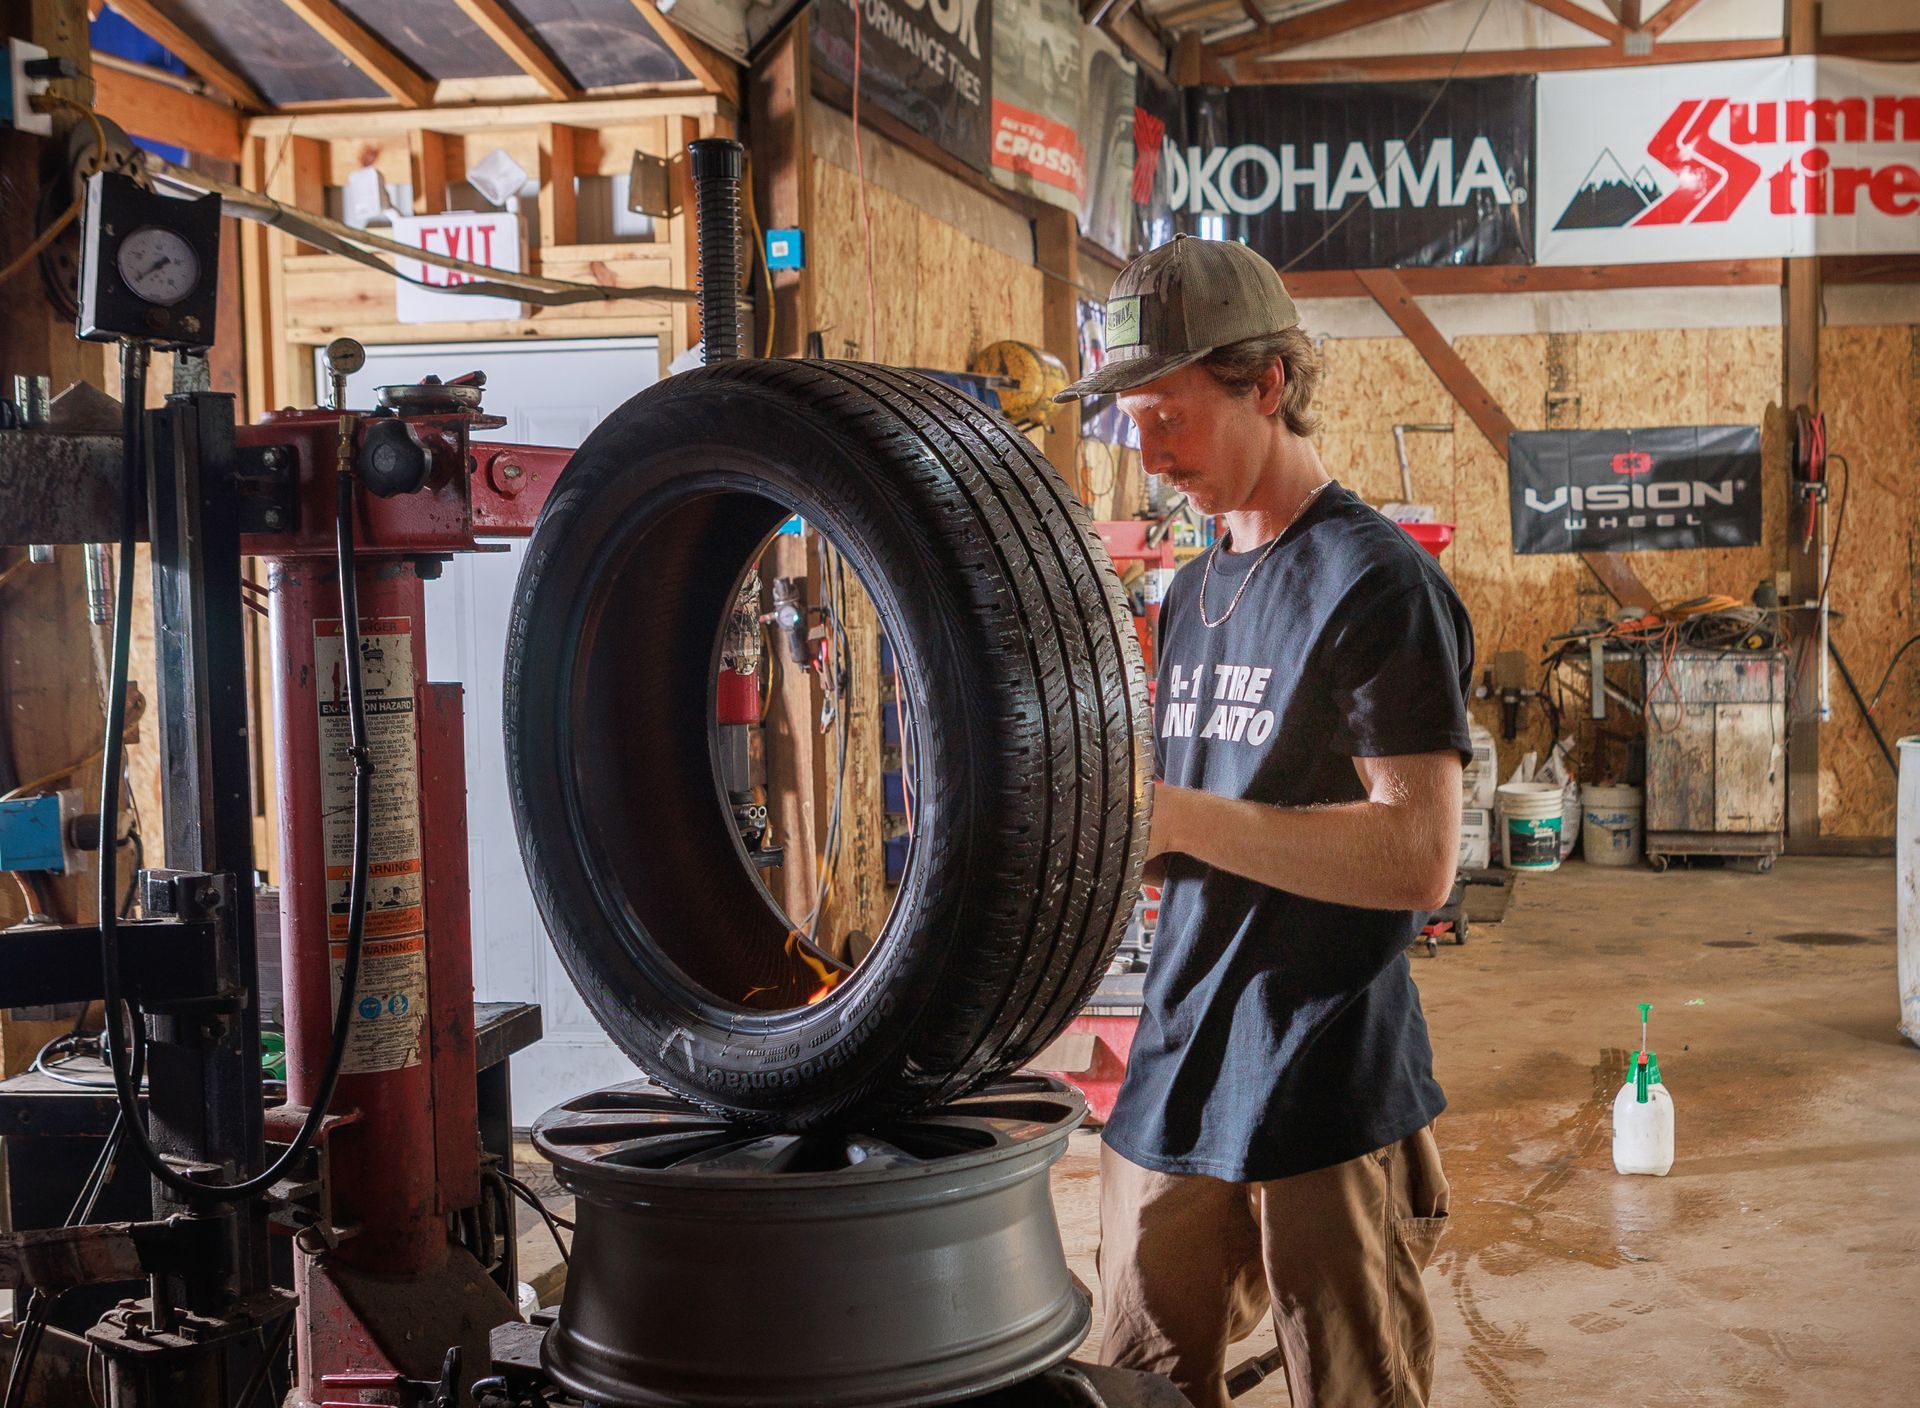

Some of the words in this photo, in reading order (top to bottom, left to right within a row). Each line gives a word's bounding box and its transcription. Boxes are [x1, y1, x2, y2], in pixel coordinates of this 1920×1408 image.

[849, 0, 946, 76] ORMANCE
[1162, 134, 1513, 215] OKOHAMA
[421, 225, 495, 287] EXIT
[1525, 479, 1734, 514] VISION
[1564, 513, 1702, 530] WHEEL
[357, 621, 397, 632] NGER
[1213, 664, 1272, 704] TIRE
[380, 700, 411, 711] HAZARD
[369, 862, 411, 874] ARNING
[362, 942, 413, 955] WARNING
